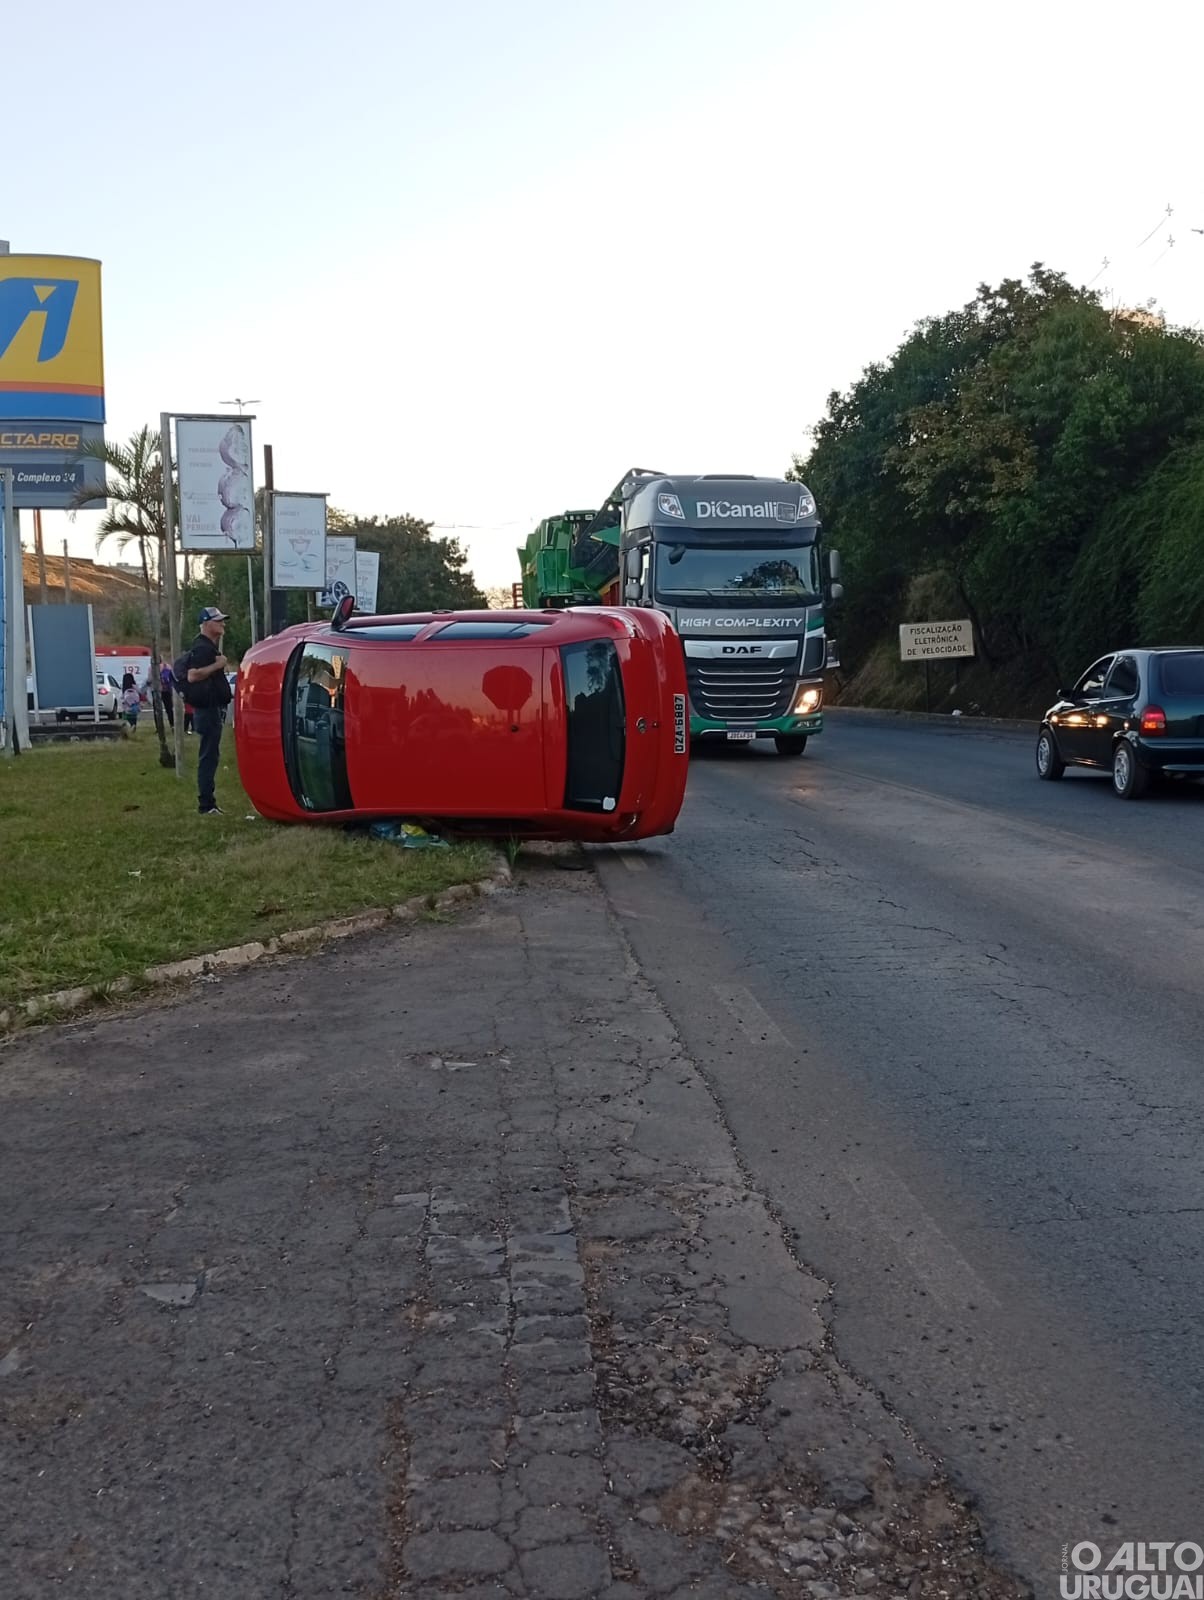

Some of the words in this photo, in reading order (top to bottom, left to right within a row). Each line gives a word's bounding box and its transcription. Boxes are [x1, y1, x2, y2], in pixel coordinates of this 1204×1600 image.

[17, 472, 62, 484] Complexo
[696, 500, 777, 518] DiCanalli
[680, 618, 712, 627] HIGH
[714, 618, 802, 627] COMPLEXITY
[910, 624, 962, 636] FISCALIZAÇÃO
[914, 635, 959, 645] ELETRÔNICA
[722, 646, 762, 654] DAF
[907, 648, 917, 656] DE
[921, 645, 967, 654] VELOCIDADE
[122, 665, 141, 675] 192
